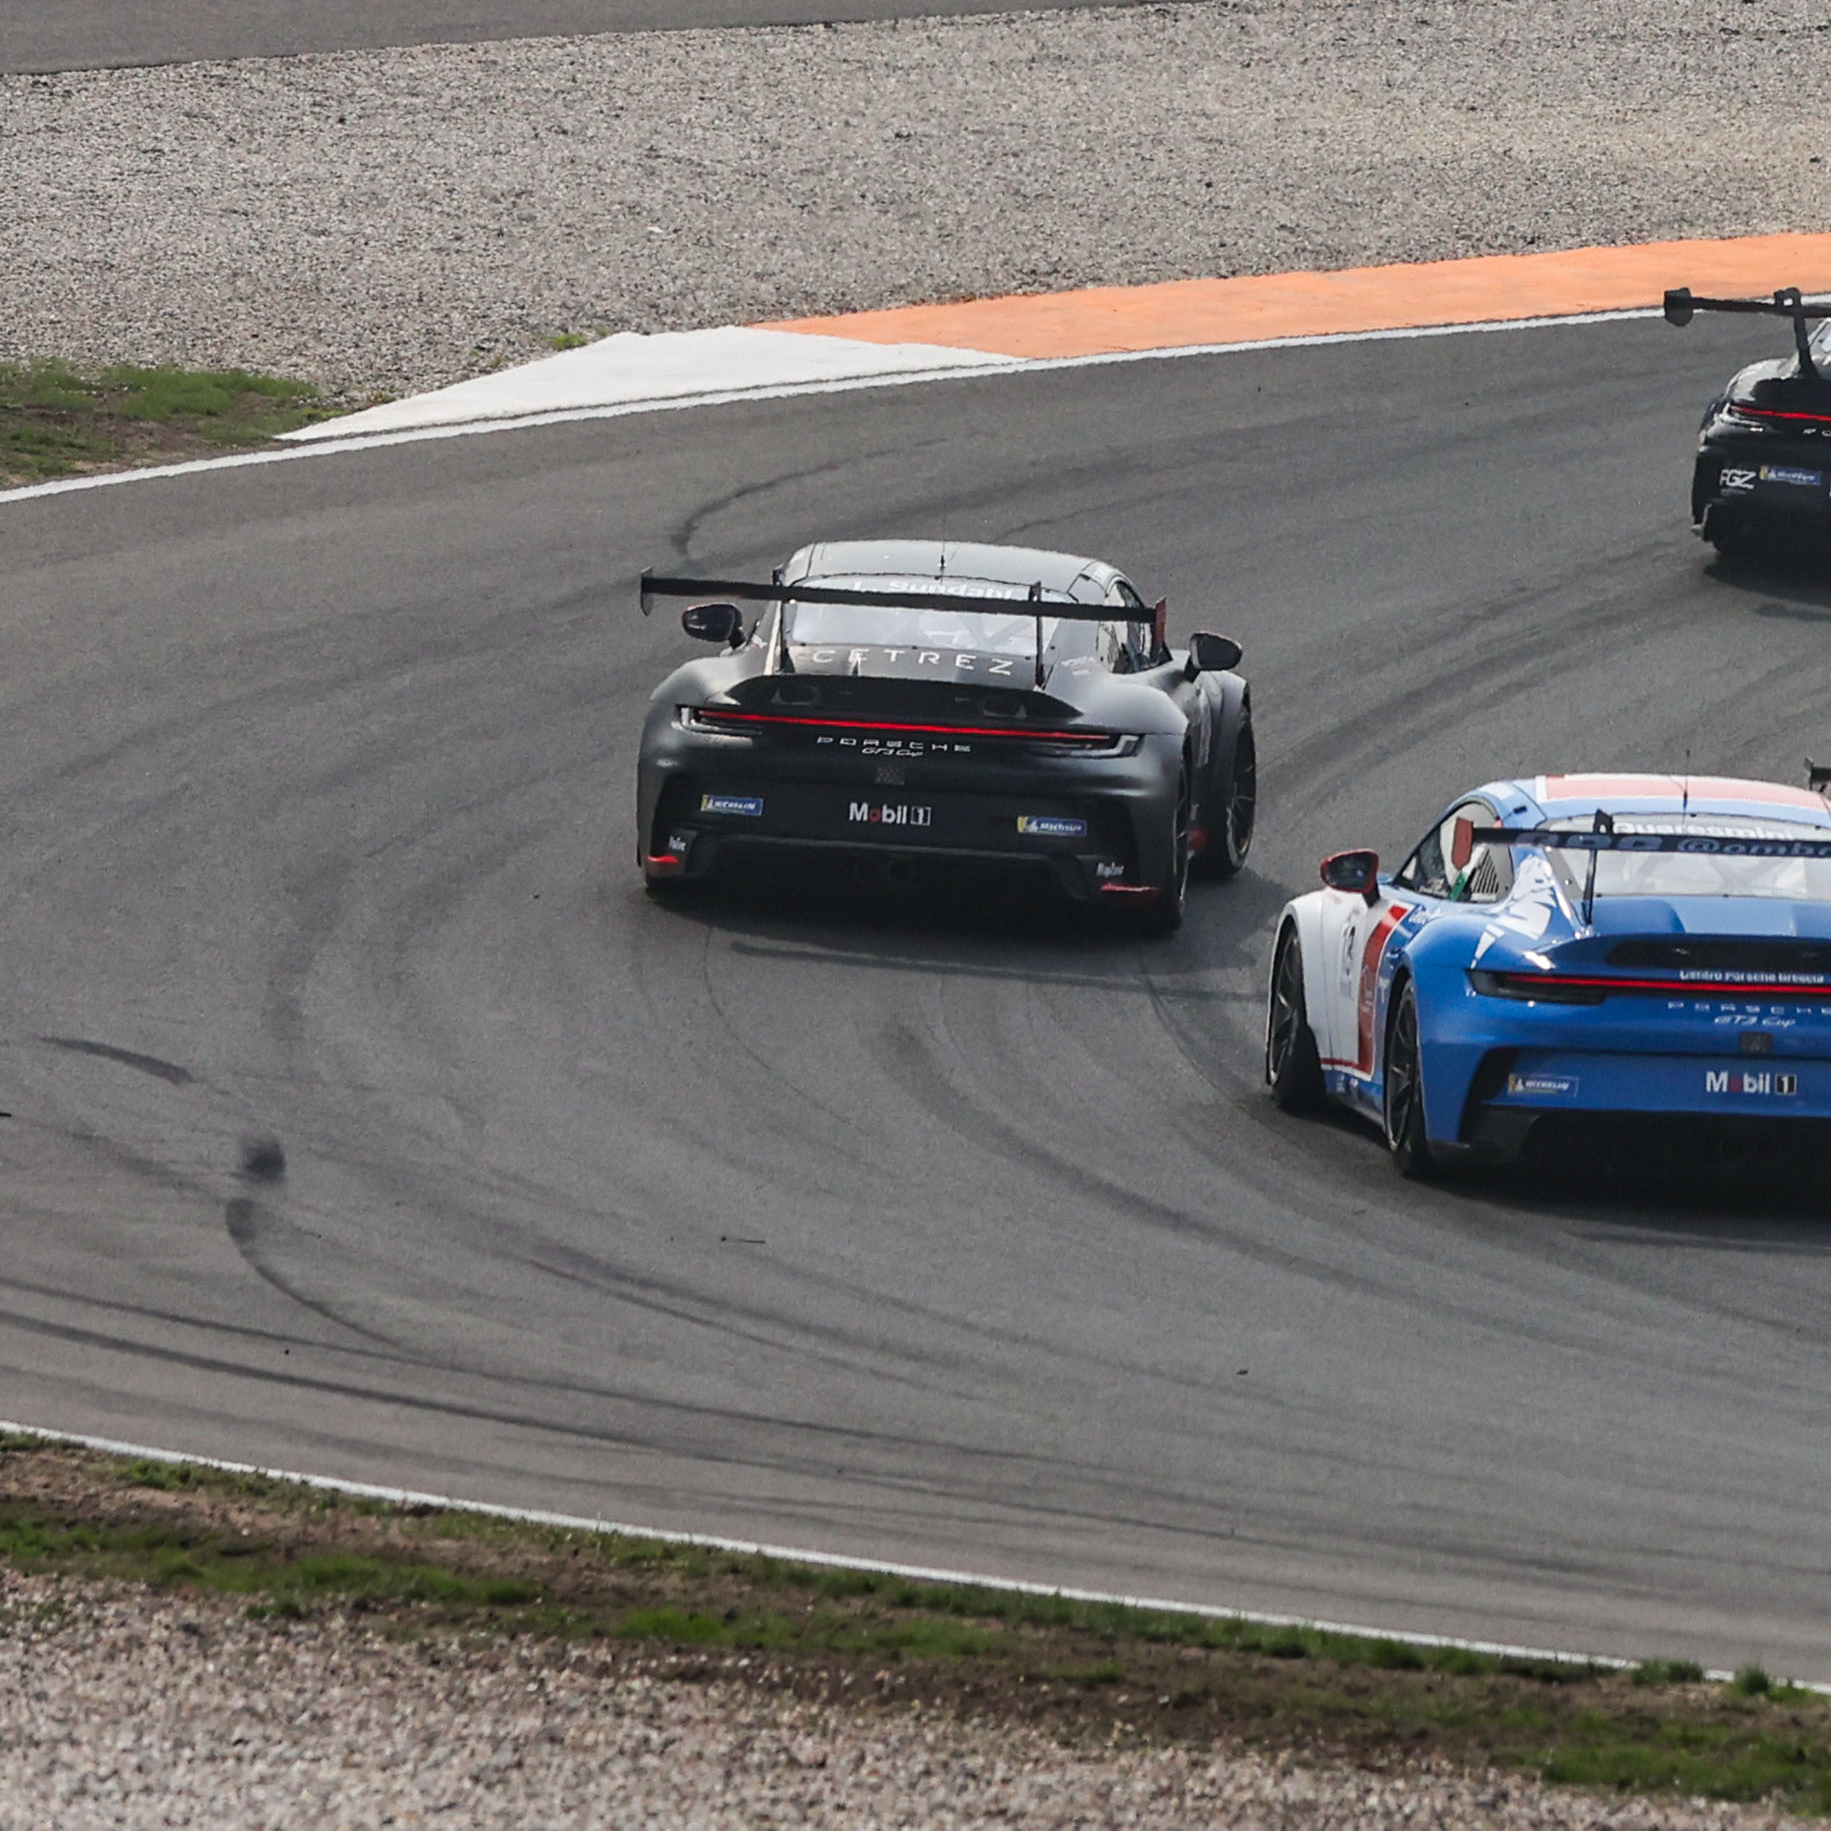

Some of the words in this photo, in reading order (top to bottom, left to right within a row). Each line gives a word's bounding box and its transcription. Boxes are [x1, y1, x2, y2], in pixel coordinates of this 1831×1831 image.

[888, 581, 1014, 601] Sundahl
[812, 647, 1015, 676] CETREZ
[816, 735, 973, 753] PORSCHE
[848, 802, 908, 826] Mobil
[1713, 1016, 1756, 1026] GT3
[1760, 1016, 1797, 1028] Cup
[1705, 1071, 1771, 1095] Mobil
